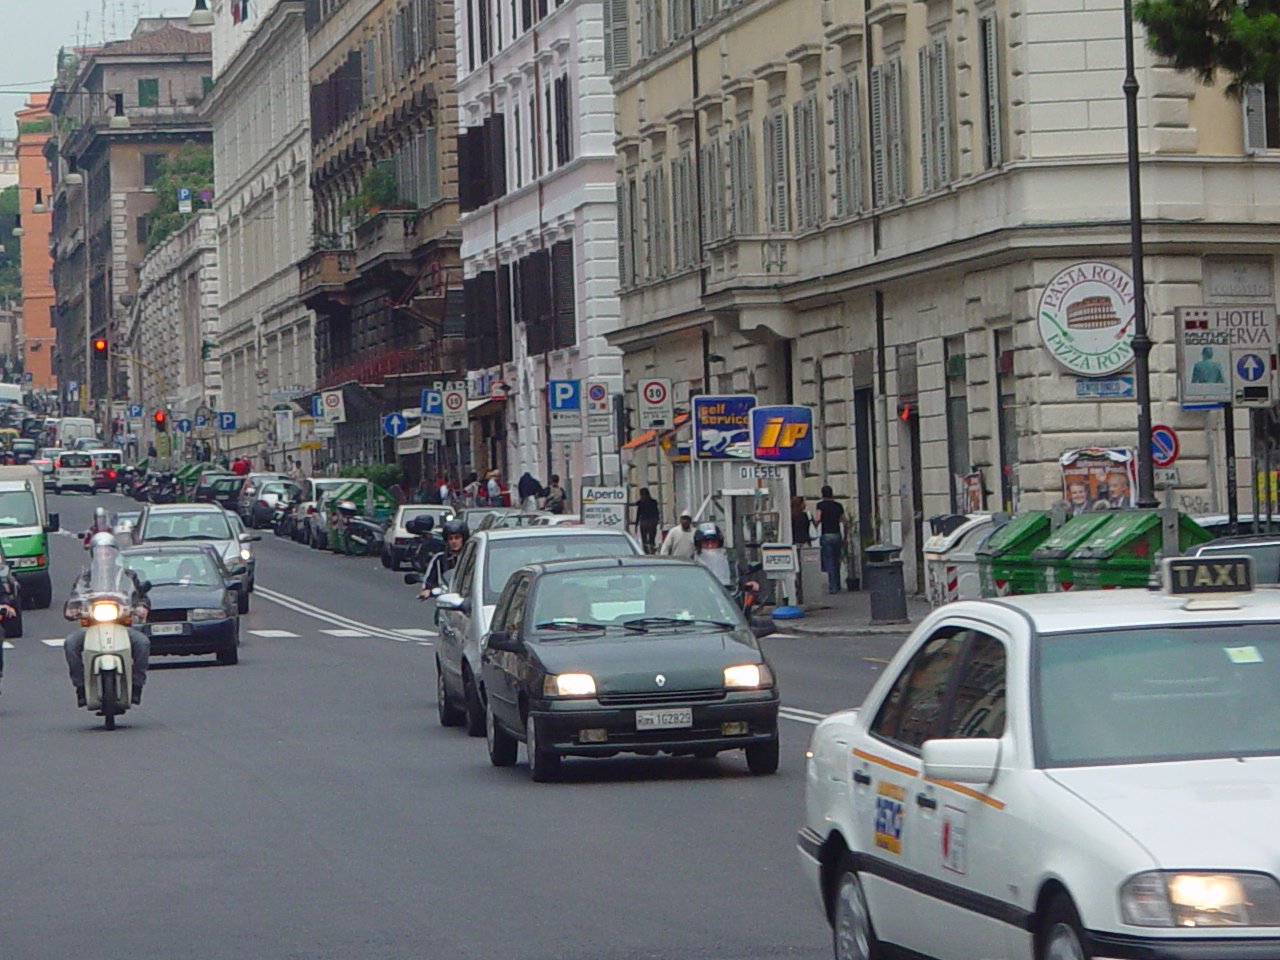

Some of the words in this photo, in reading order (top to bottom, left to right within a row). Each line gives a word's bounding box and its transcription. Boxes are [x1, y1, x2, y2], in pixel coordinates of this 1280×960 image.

[1043, 266, 1088, 308] PASTA
[1215, 310, 1269, 327] HOTEL
[1185, 338, 1229, 346] SOCIALE
[1047, 333, 1091, 370] PIZZA
[555, 383, 574, 408] P
[649, 388, 661, 399] 30
[426, 392, 441, 412] P
[700, 403, 726, 415] self
[132, 406, 141, 417] P
[222, 414, 234, 428] P
[741, 466, 782, 479] DIESEL
[587, 489, 625, 500] Aperto
[1172, 563, 1247, 588] TAXI
